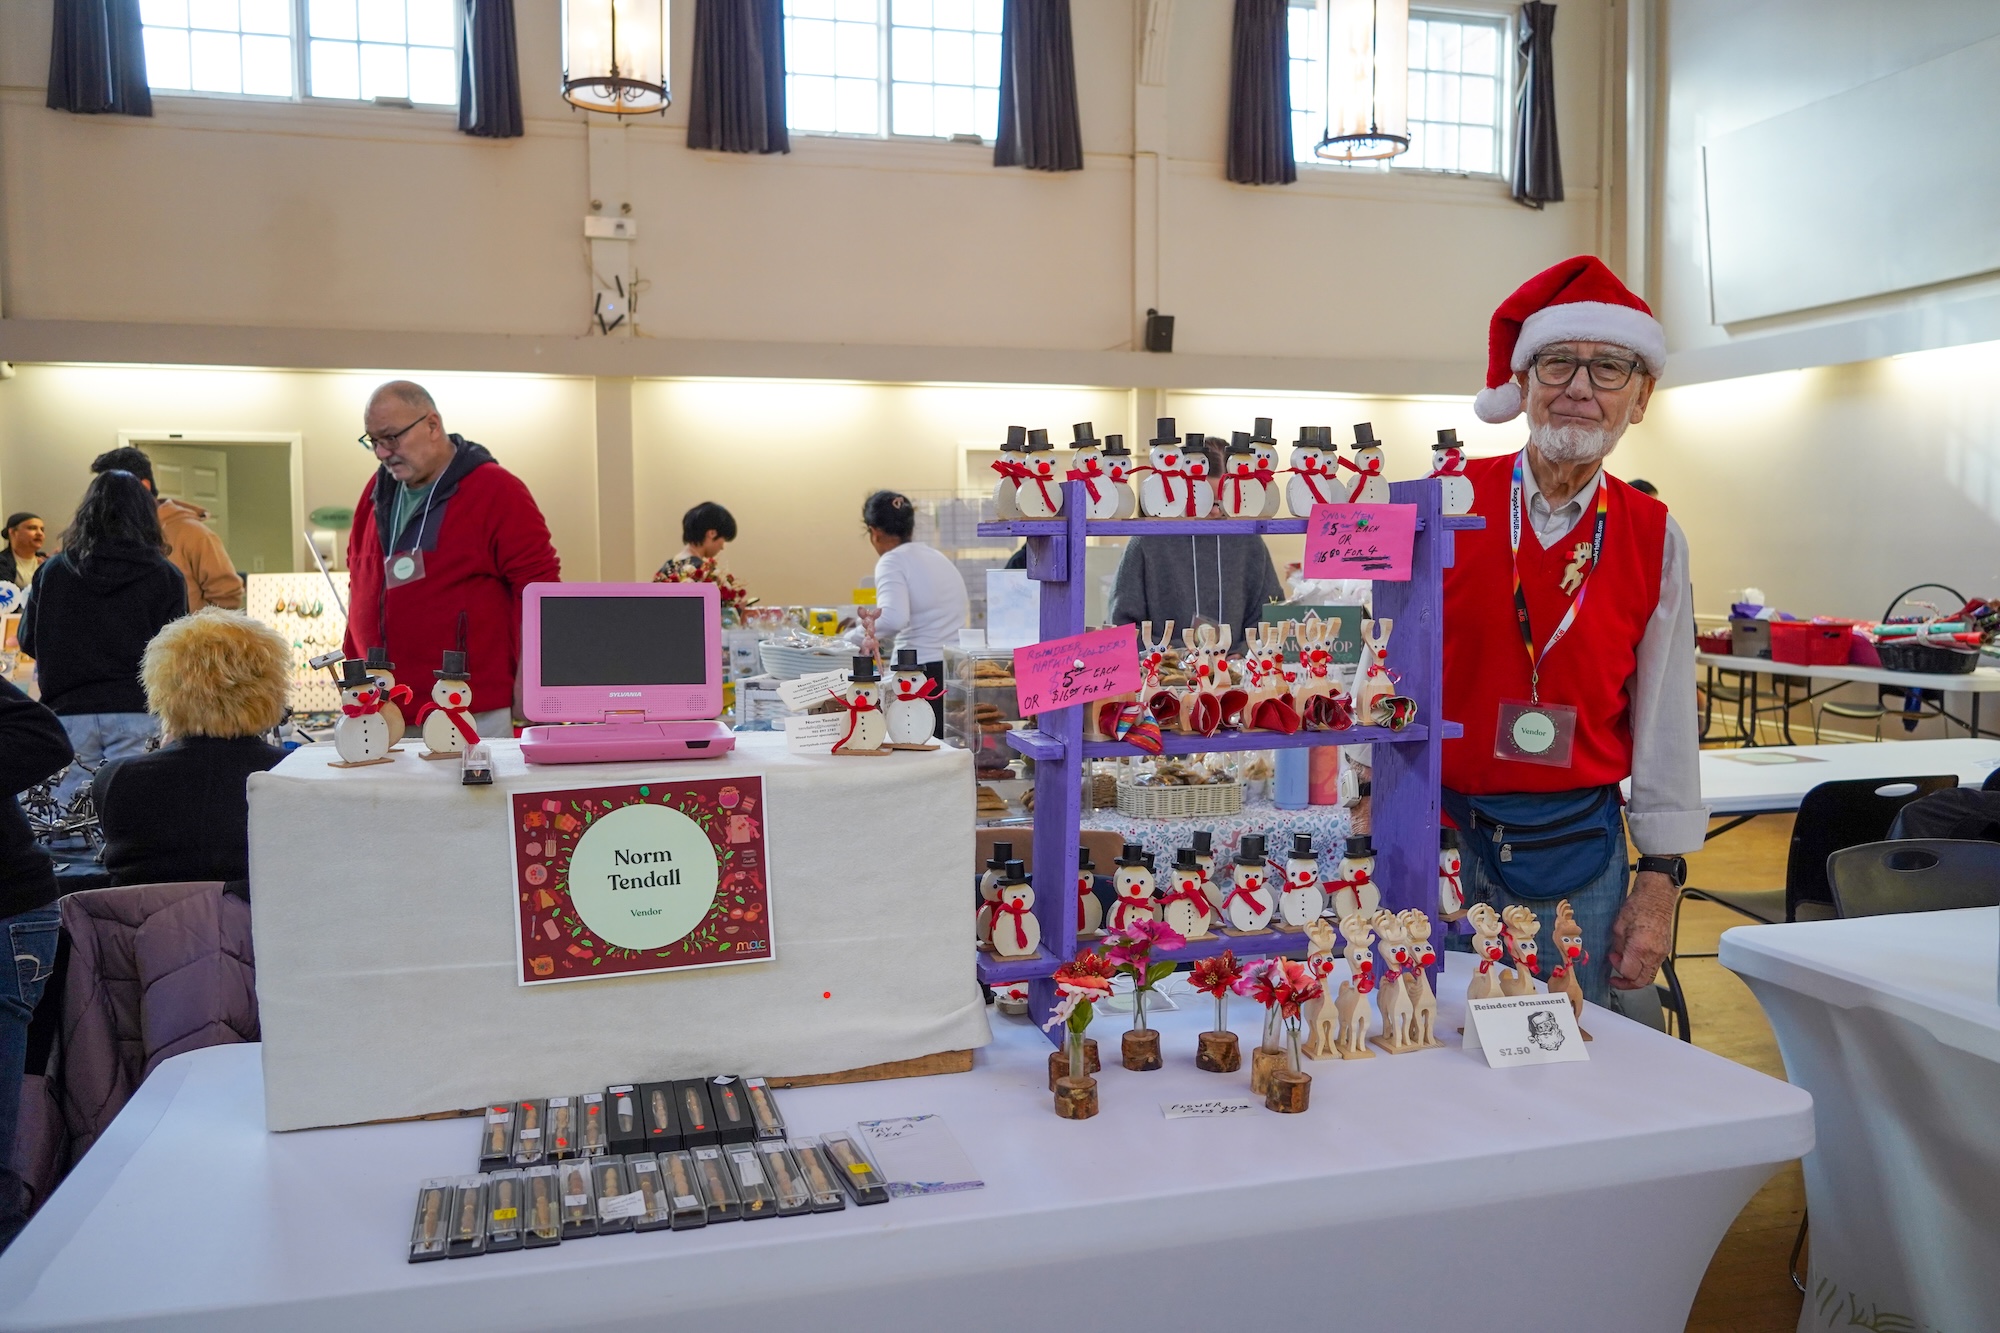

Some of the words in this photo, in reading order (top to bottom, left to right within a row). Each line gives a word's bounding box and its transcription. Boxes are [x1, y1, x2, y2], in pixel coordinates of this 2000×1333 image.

[1320, 510, 1347, 522] SNOW
[1338, 534, 1352, 546] OR
[1344, 548, 1364, 557] FOR
[1367, 545, 1378, 556] 4
[1031, 656, 1074, 674] NAPKIN
[1076, 639, 1127, 659] HOLDERS
[1093, 664, 1120, 678] EACH
[1024, 694, 1040, 710] OR
[1082, 684, 1099, 696] FOR
[1103, 678, 1116, 691] 4
[1521, 727, 1547, 737] Vendor
[614, 848, 673, 867] Norm
[607, 868, 681, 891] Tendall
[630, 907, 663, 918] Vendor
[736, 939, 767, 951] mac
[1473, 1002, 1517, 1011] Reindeer
[1518, 997, 1566, 1007] Ornament
[1499, 1046, 1531, 1057] $7.50
[1171, 1101, 1222, 1110] FLOWER
[864, 1125, 893, 1133] TRY
